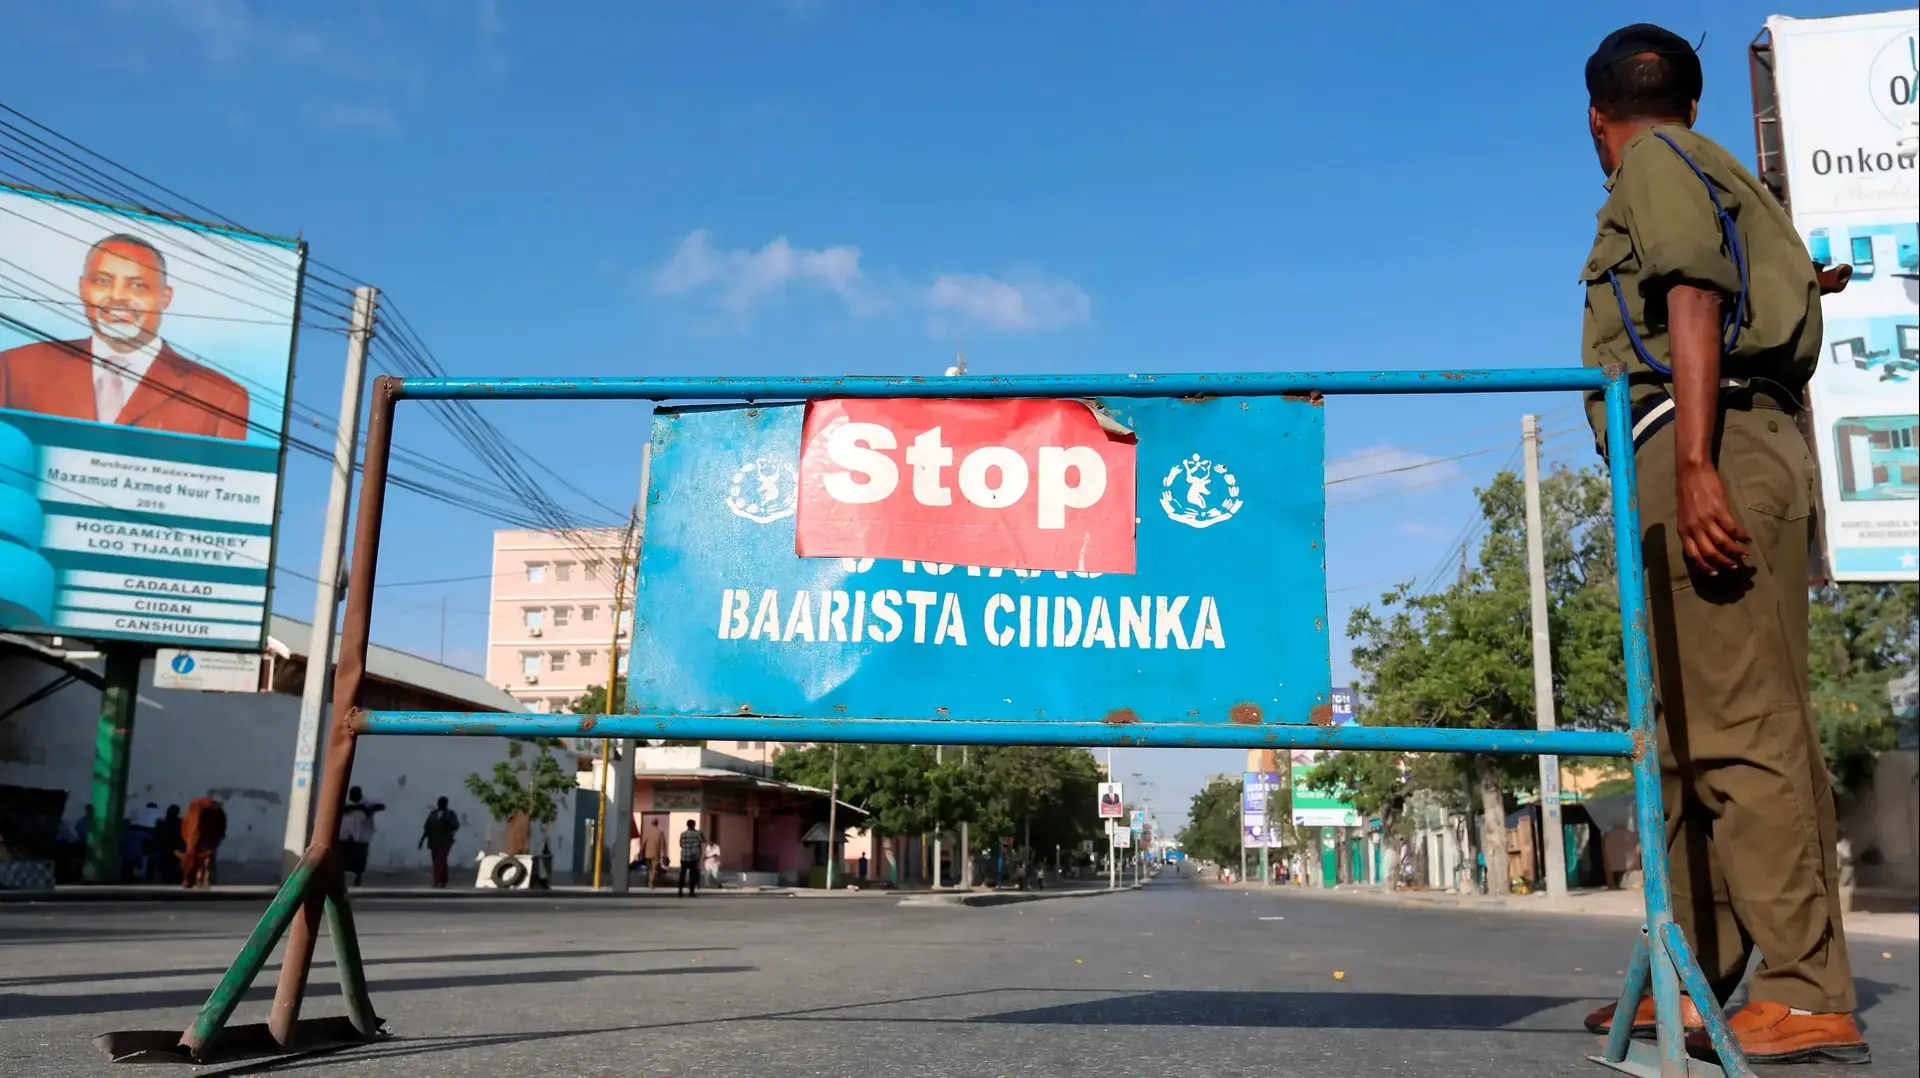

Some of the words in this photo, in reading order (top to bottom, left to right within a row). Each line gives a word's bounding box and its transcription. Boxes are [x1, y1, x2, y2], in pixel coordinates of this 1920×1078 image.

[47, 467, 118, 488] Maxamud
[123, 477, 172, 495] Axmed
[177, 483, 210, 499] Nuur
[215, 488, 260, 504] Tarsan
[823, 422, 1107, 529] Stop
[76, 521, 184, 542] HOGAAMIYE
[190, 534, 248, 548] HOREY
[88, 538, 125, 551] LOO
[131, 542, 235, 562] TIJAABIYEY
[124, 577, 213, 595] CADAALAD
[134, 600, 192, 614] CIIDAN
[718, 589, 967, 646] BAARISTA
[983, 593, 1226, 650] CIIDANKA
[115, 618, 209, 635] CANSHUUR
